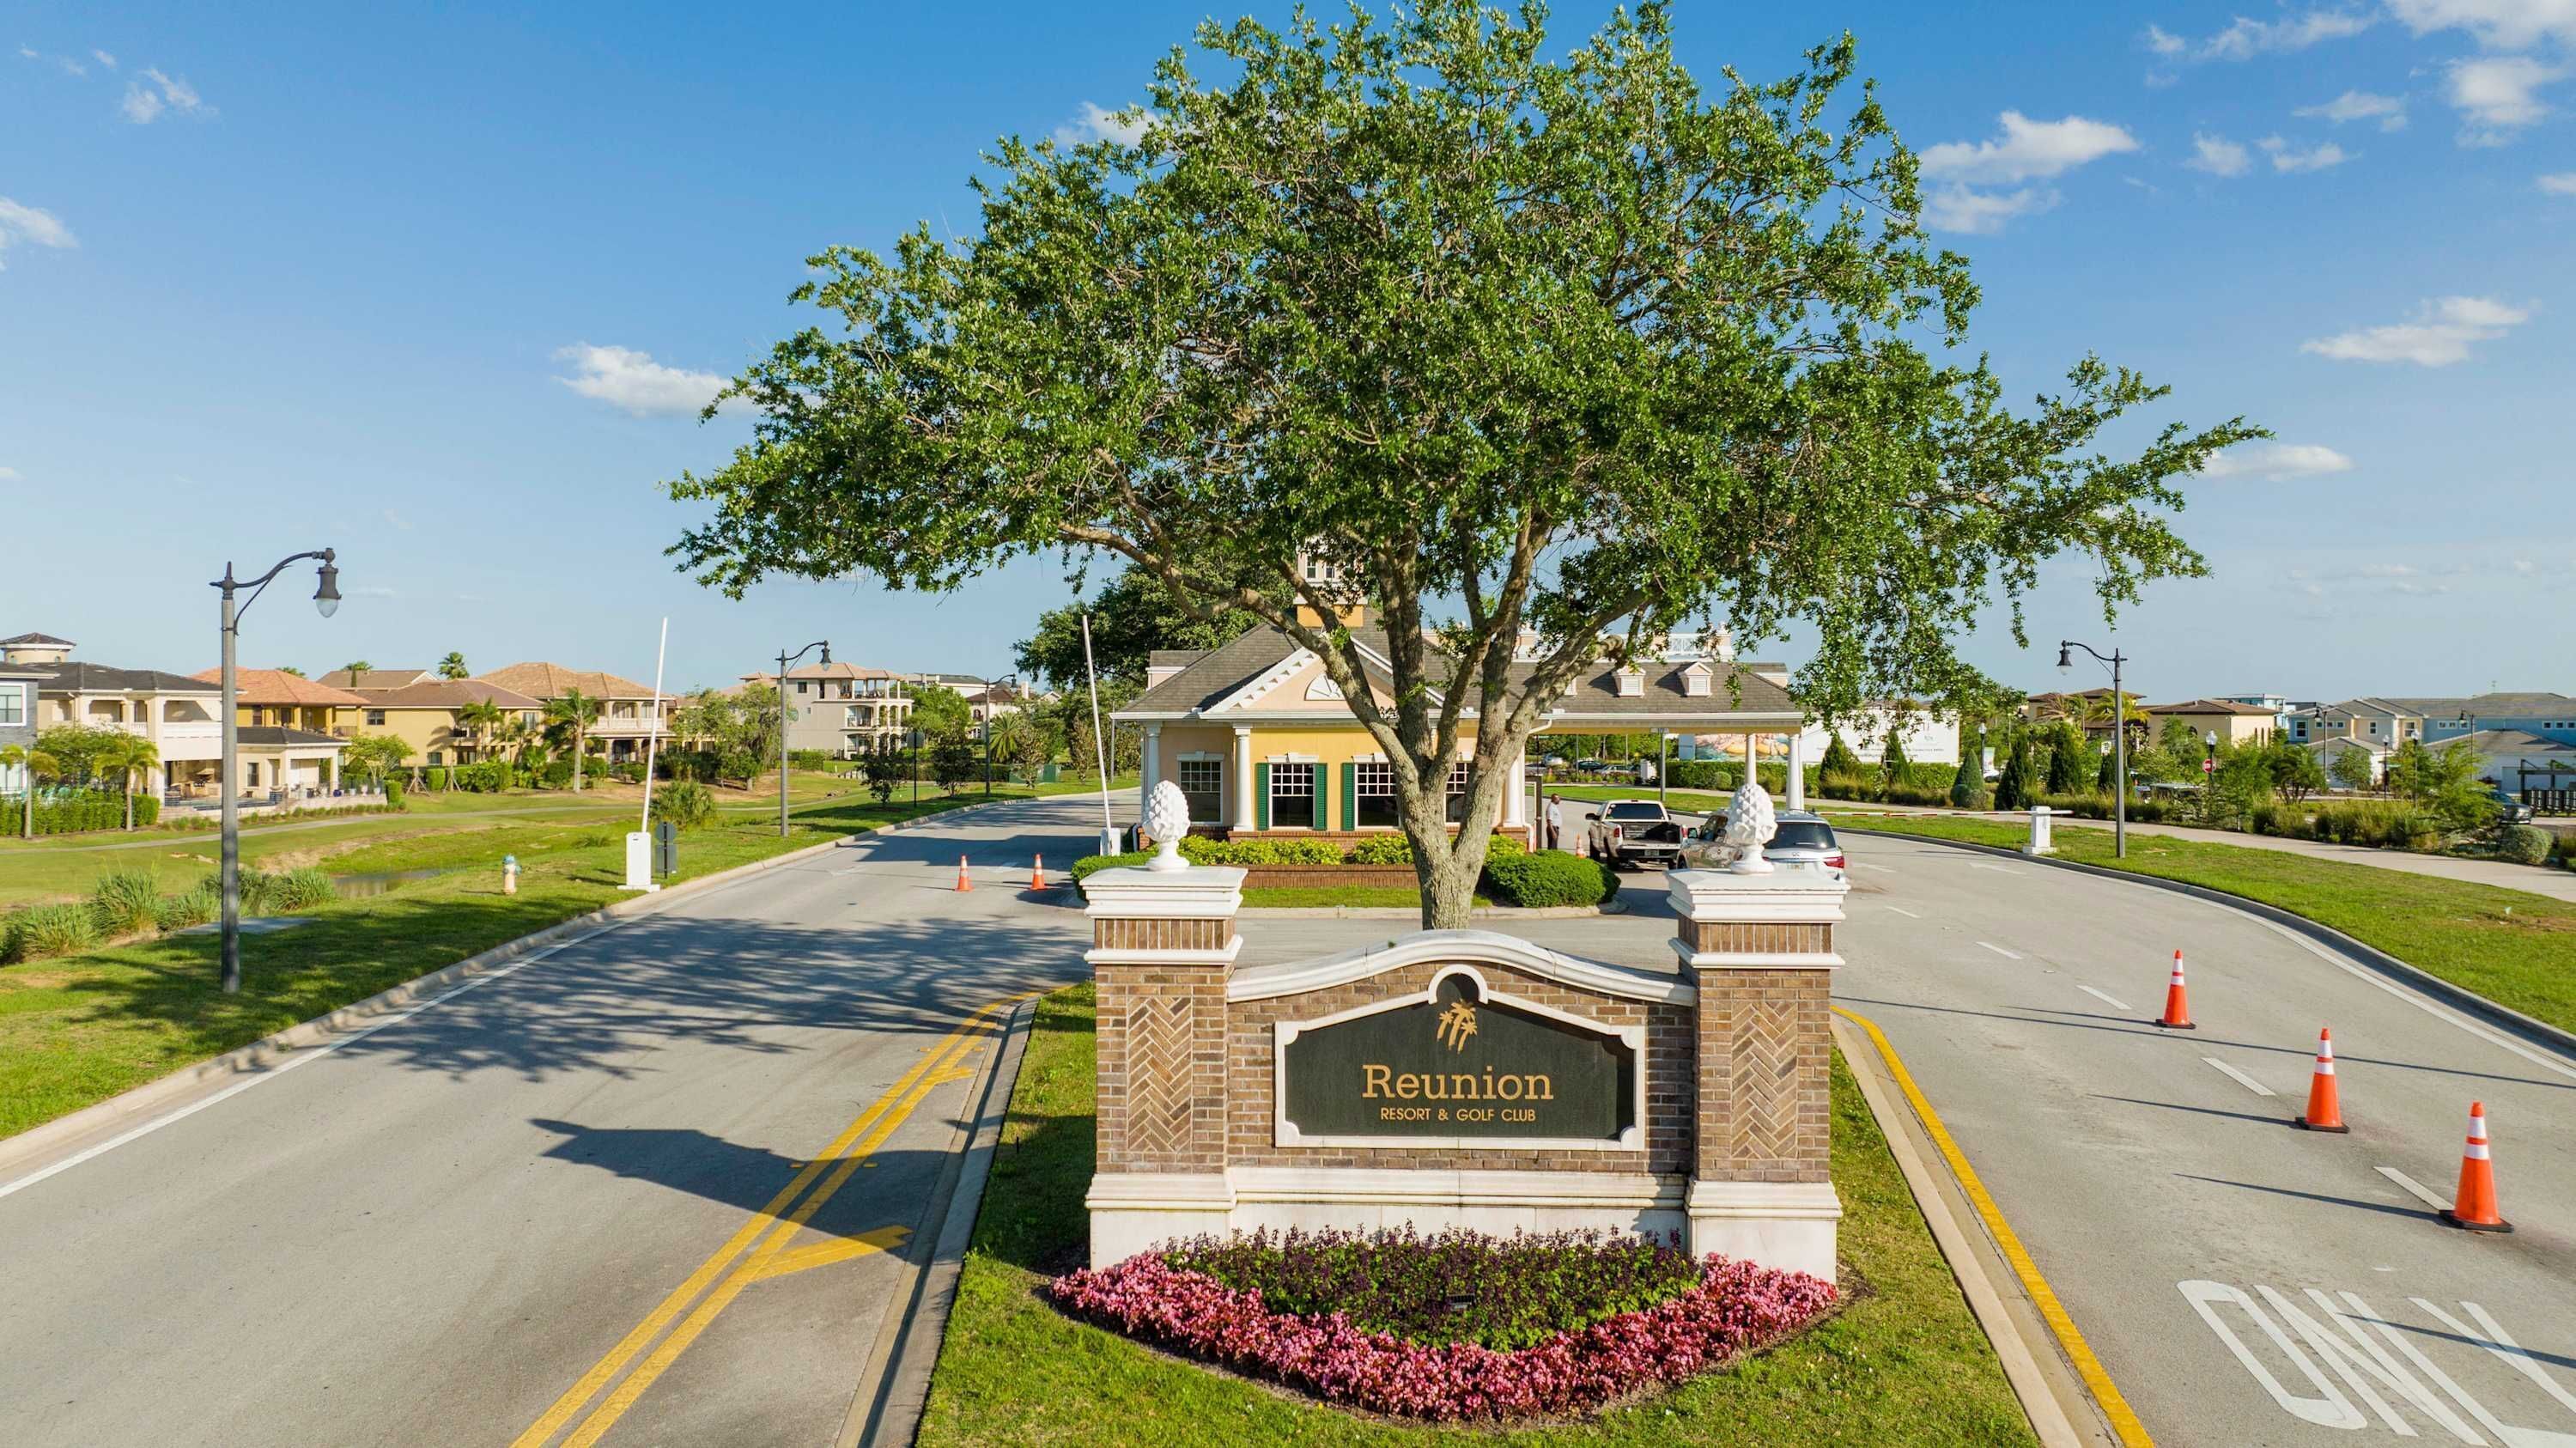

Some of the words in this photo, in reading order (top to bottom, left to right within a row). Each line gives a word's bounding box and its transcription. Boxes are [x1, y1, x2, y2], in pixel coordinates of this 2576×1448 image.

[1362, 1064, 1554, 1100] Reunion
[1381, 1108, 1431, 1121] RESORT
[1437, 1108, 1449, 1121] &
[1456, 1109, 1495, 1122] GOLF
[1501, 1109, 1536, 1122] CLUB
[2177, 1280, 2576, 1448] ONLY
